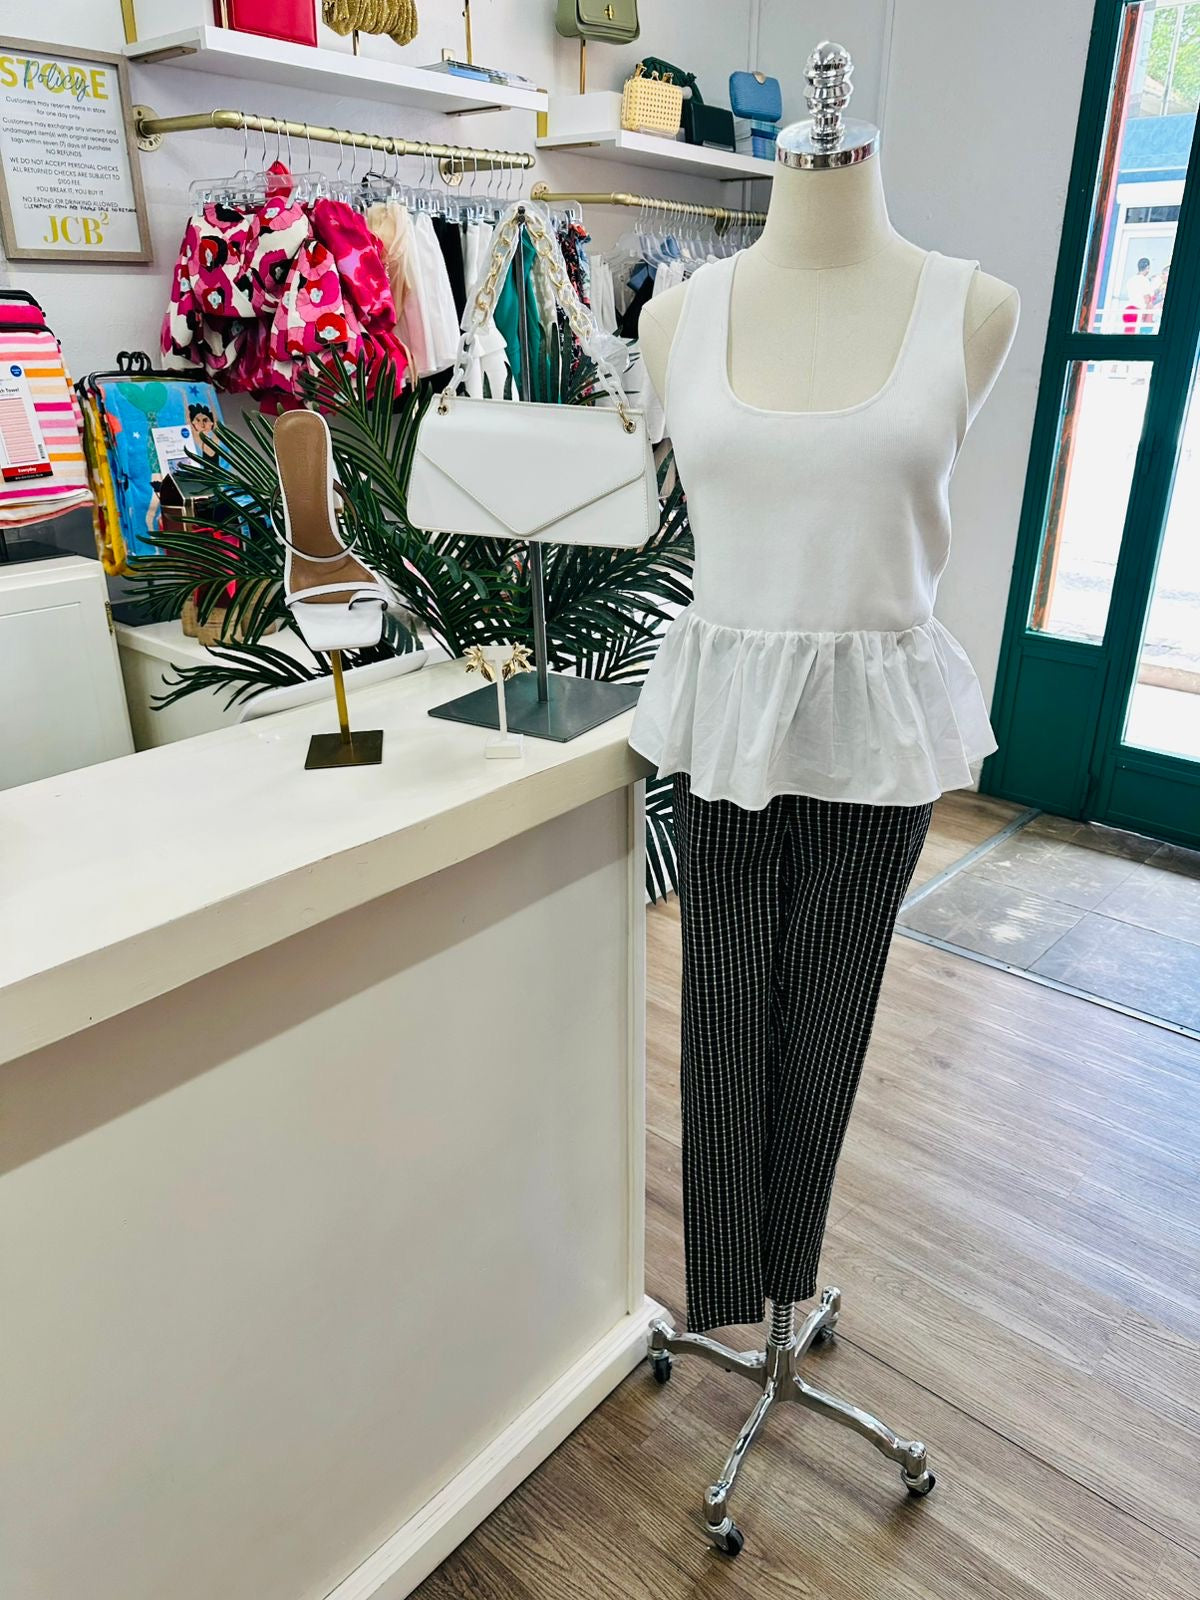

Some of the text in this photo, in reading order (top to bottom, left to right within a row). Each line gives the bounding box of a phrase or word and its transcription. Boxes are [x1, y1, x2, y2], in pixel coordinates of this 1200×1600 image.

[0, 56, 109, 100] STORE
[23, 60, 90, 102] Policy
[5, 96, 36, 105] Customers
[2, 117, 33, 126] Customers
[47, 123, 73, 131] exchange
[2, 127, 37, 136] undamaged
[24, 166, 52, 175] RETURNED
[53, 169, 77, 177] CHECKS
[68, 162, 96, 170] PERSONAL
